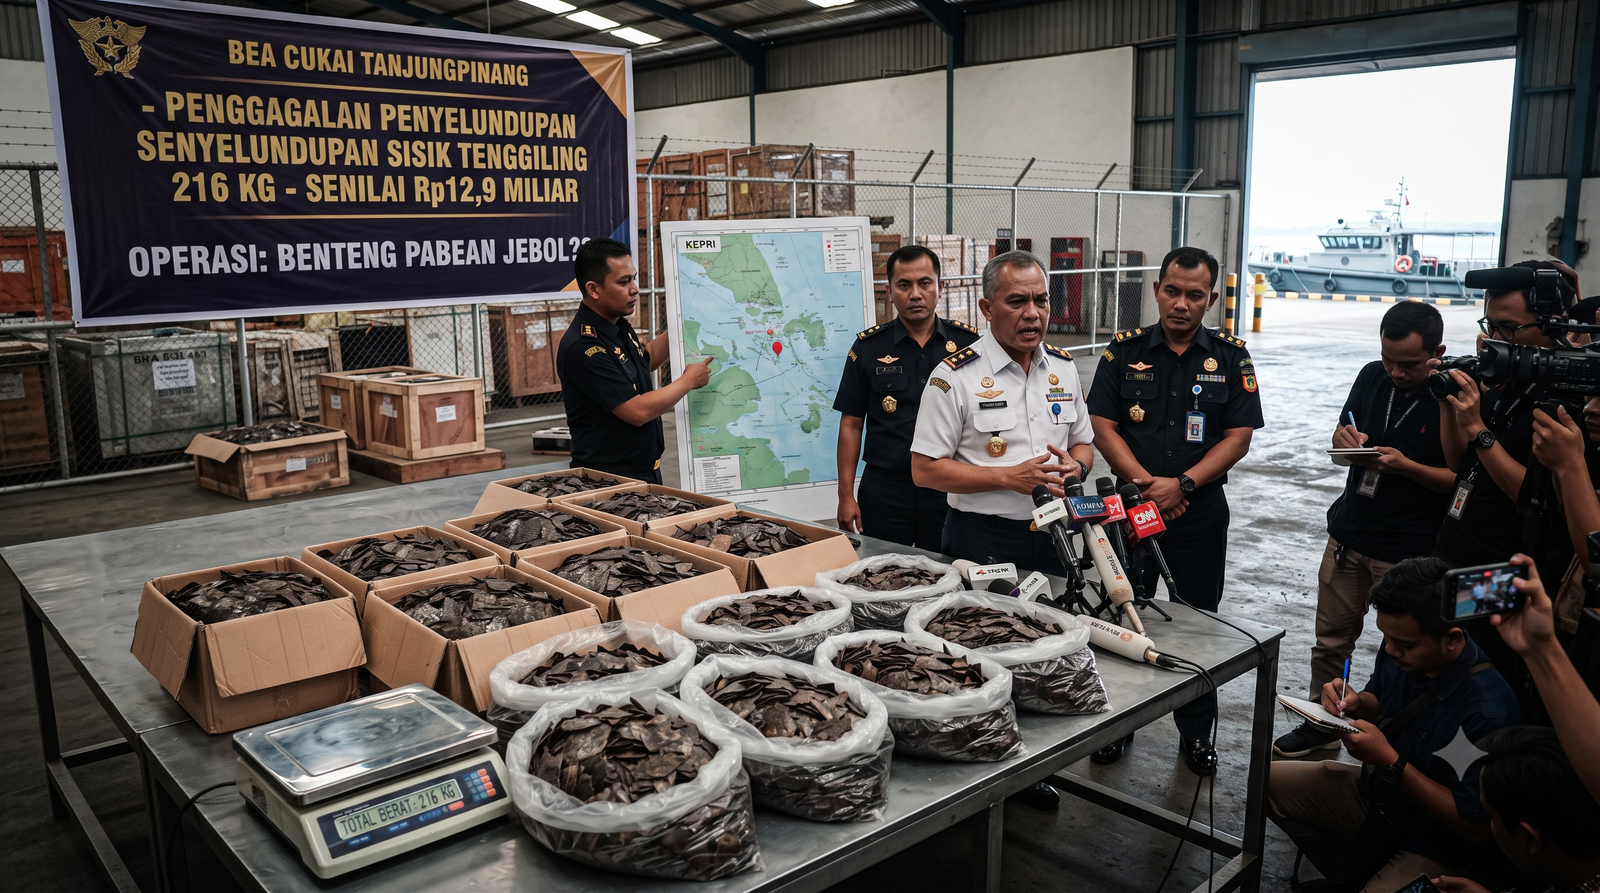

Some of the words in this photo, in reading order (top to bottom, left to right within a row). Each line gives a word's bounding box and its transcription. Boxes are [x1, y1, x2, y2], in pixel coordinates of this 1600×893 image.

[228, 39, 276, 67] BEA
[284, 44, 354, 74] CUKAI
[361, 51, 529, 87] TANJUNGPINANG
[166, 91, 371, 130] PENGGAGALAN
[380, 103, 576, 139] PENYELUNDUPAN
[137, 130, 378, 167] SENYELUNDUPAN
[387, 141, 452, 168] SISIK
[458, 143, 588, 172] TENGGILING
[173, 172, 228, 202] 216
[239, 173, 275, 202] KG
[306, 174, 405, 203] SENILAI
[414, 175, 495, 208] Rp12,9
[504, 178, 578, 203] MILIAR
[128, 244, 267, 277] OPERASI:
[278, 241, 396, 272] BENTENG
[405, 238, 495, 268] PABEAN
[685, 240, 716, 249] KEPRI
[1133, 508, 1157, 525] CNN
[340, 815, 377, 835] TOTAL
[418, 790, 438, 809] 216
[440, 784, 456, 800] KG
